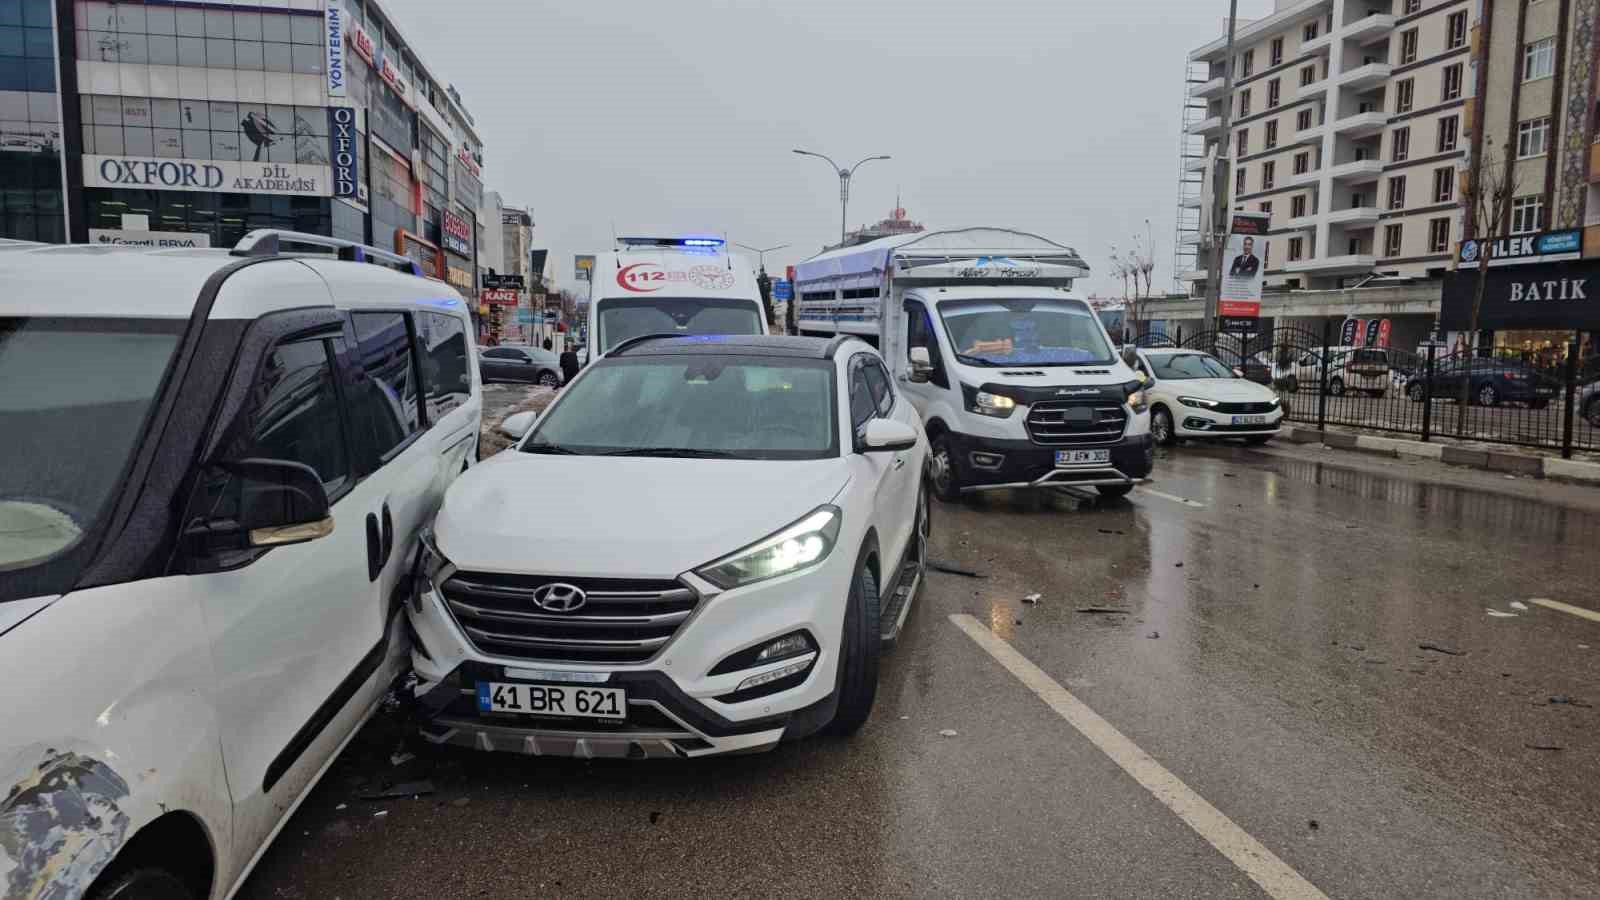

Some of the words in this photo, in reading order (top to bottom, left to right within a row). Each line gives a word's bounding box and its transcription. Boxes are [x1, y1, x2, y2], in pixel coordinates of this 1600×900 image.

[334, 109, 354, 195] OXFORD
[100, 159, 223, 189] OXFORD
[263, 164, 290, 179] DİL
[233, 177, 316, 192] AKADEMİSİ
[626, 271, 665, 282] 112
[485, 291, 513, 302] KANZ
[1509, 278, 1587, 302] BATİK
[493, 685, 522, 710] 41
[530, 687, 566, 713] BR
[575, 689, 621, 715] 621
